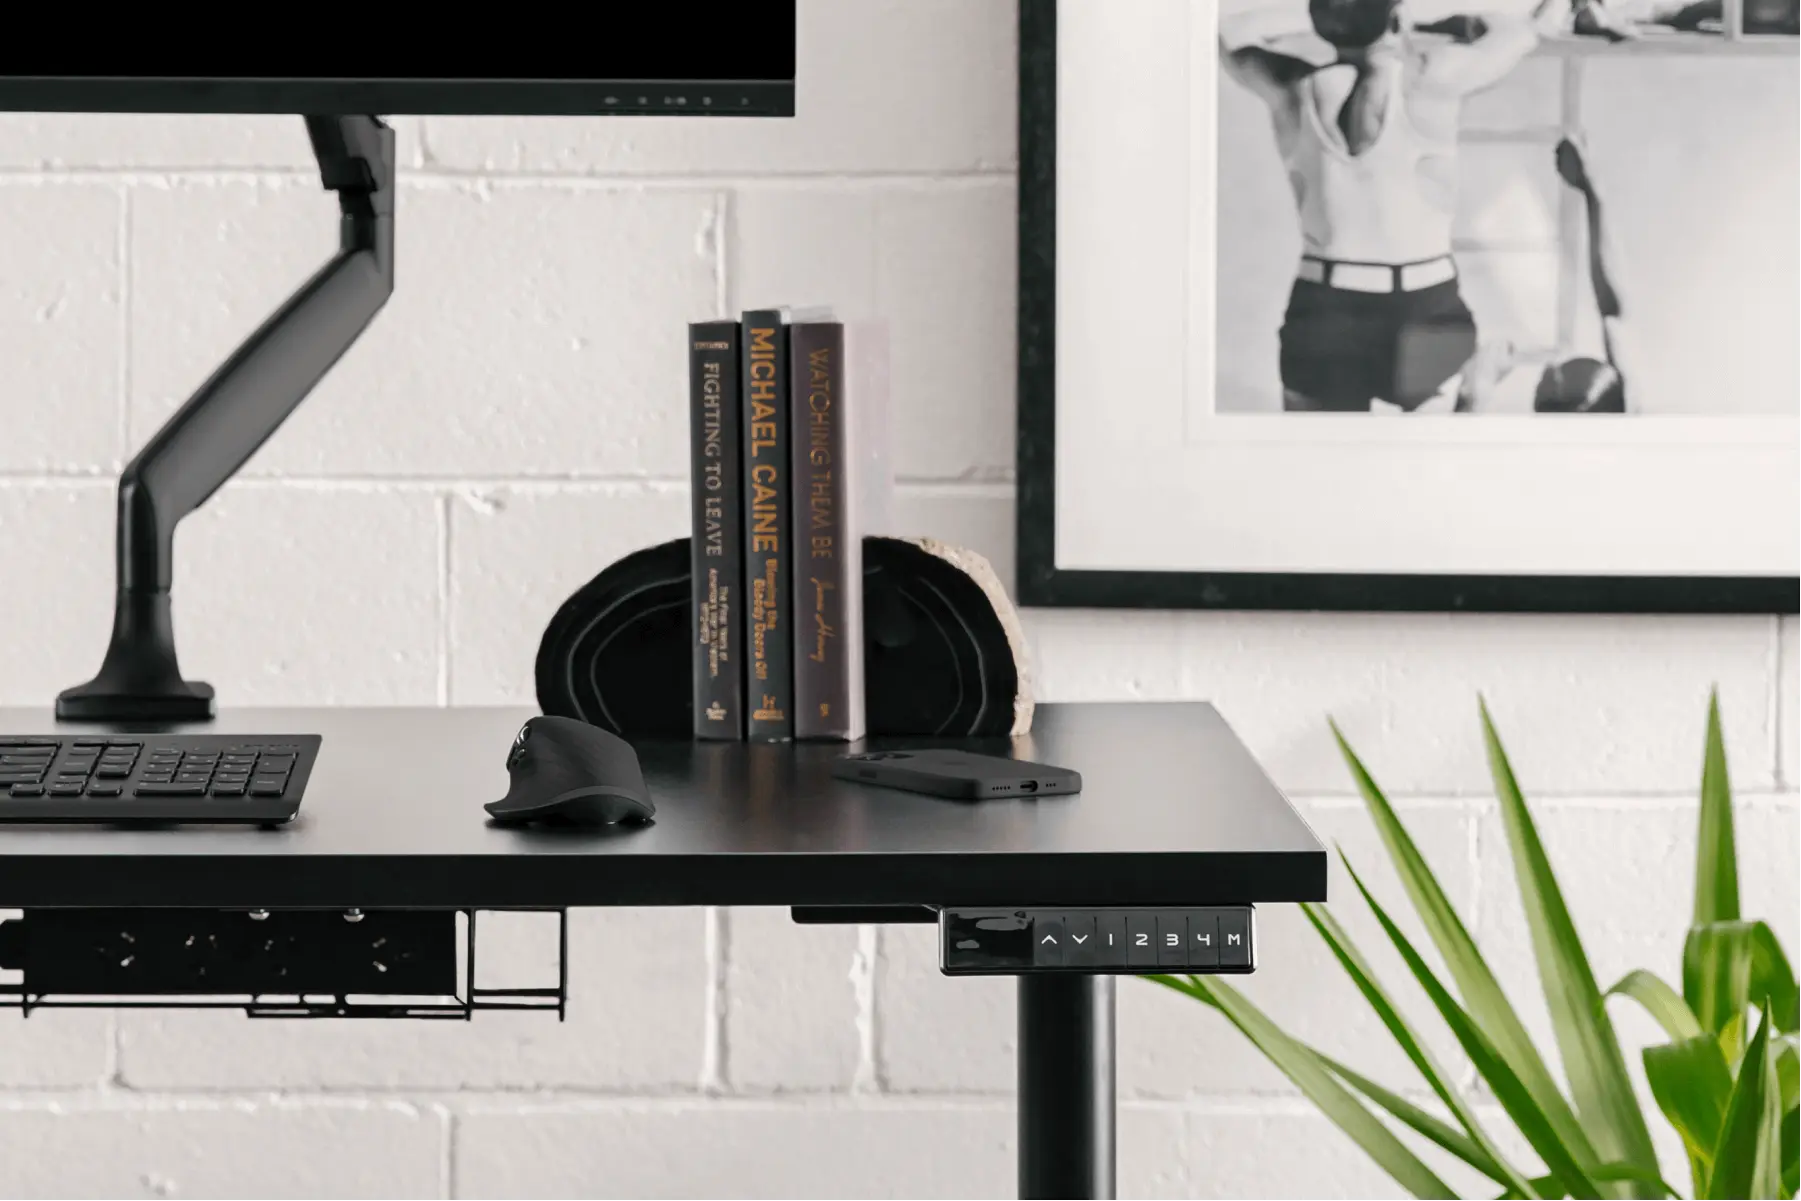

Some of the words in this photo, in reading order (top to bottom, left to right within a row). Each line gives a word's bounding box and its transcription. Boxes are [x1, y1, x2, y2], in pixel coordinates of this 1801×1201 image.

[703, 362, 721, 457] FIGHTING
[750, 328, 776, 457] MICHAEL
[809, 348, 831, 465] WATCHING
[704, 461, 722, 491] TO
[810, 470, 832, 530] THEM
[705, 496, 723, 557] LEAVE
[752, 464, 778, 553] CAINE
[811, 535, 832, 559] BE
[1135, 933, 1149, 946] 2
[1166, 933, 1180, 946] 3
[1196, 933, 1211, 946] 4
[1227, 933, 1241, 946] M
